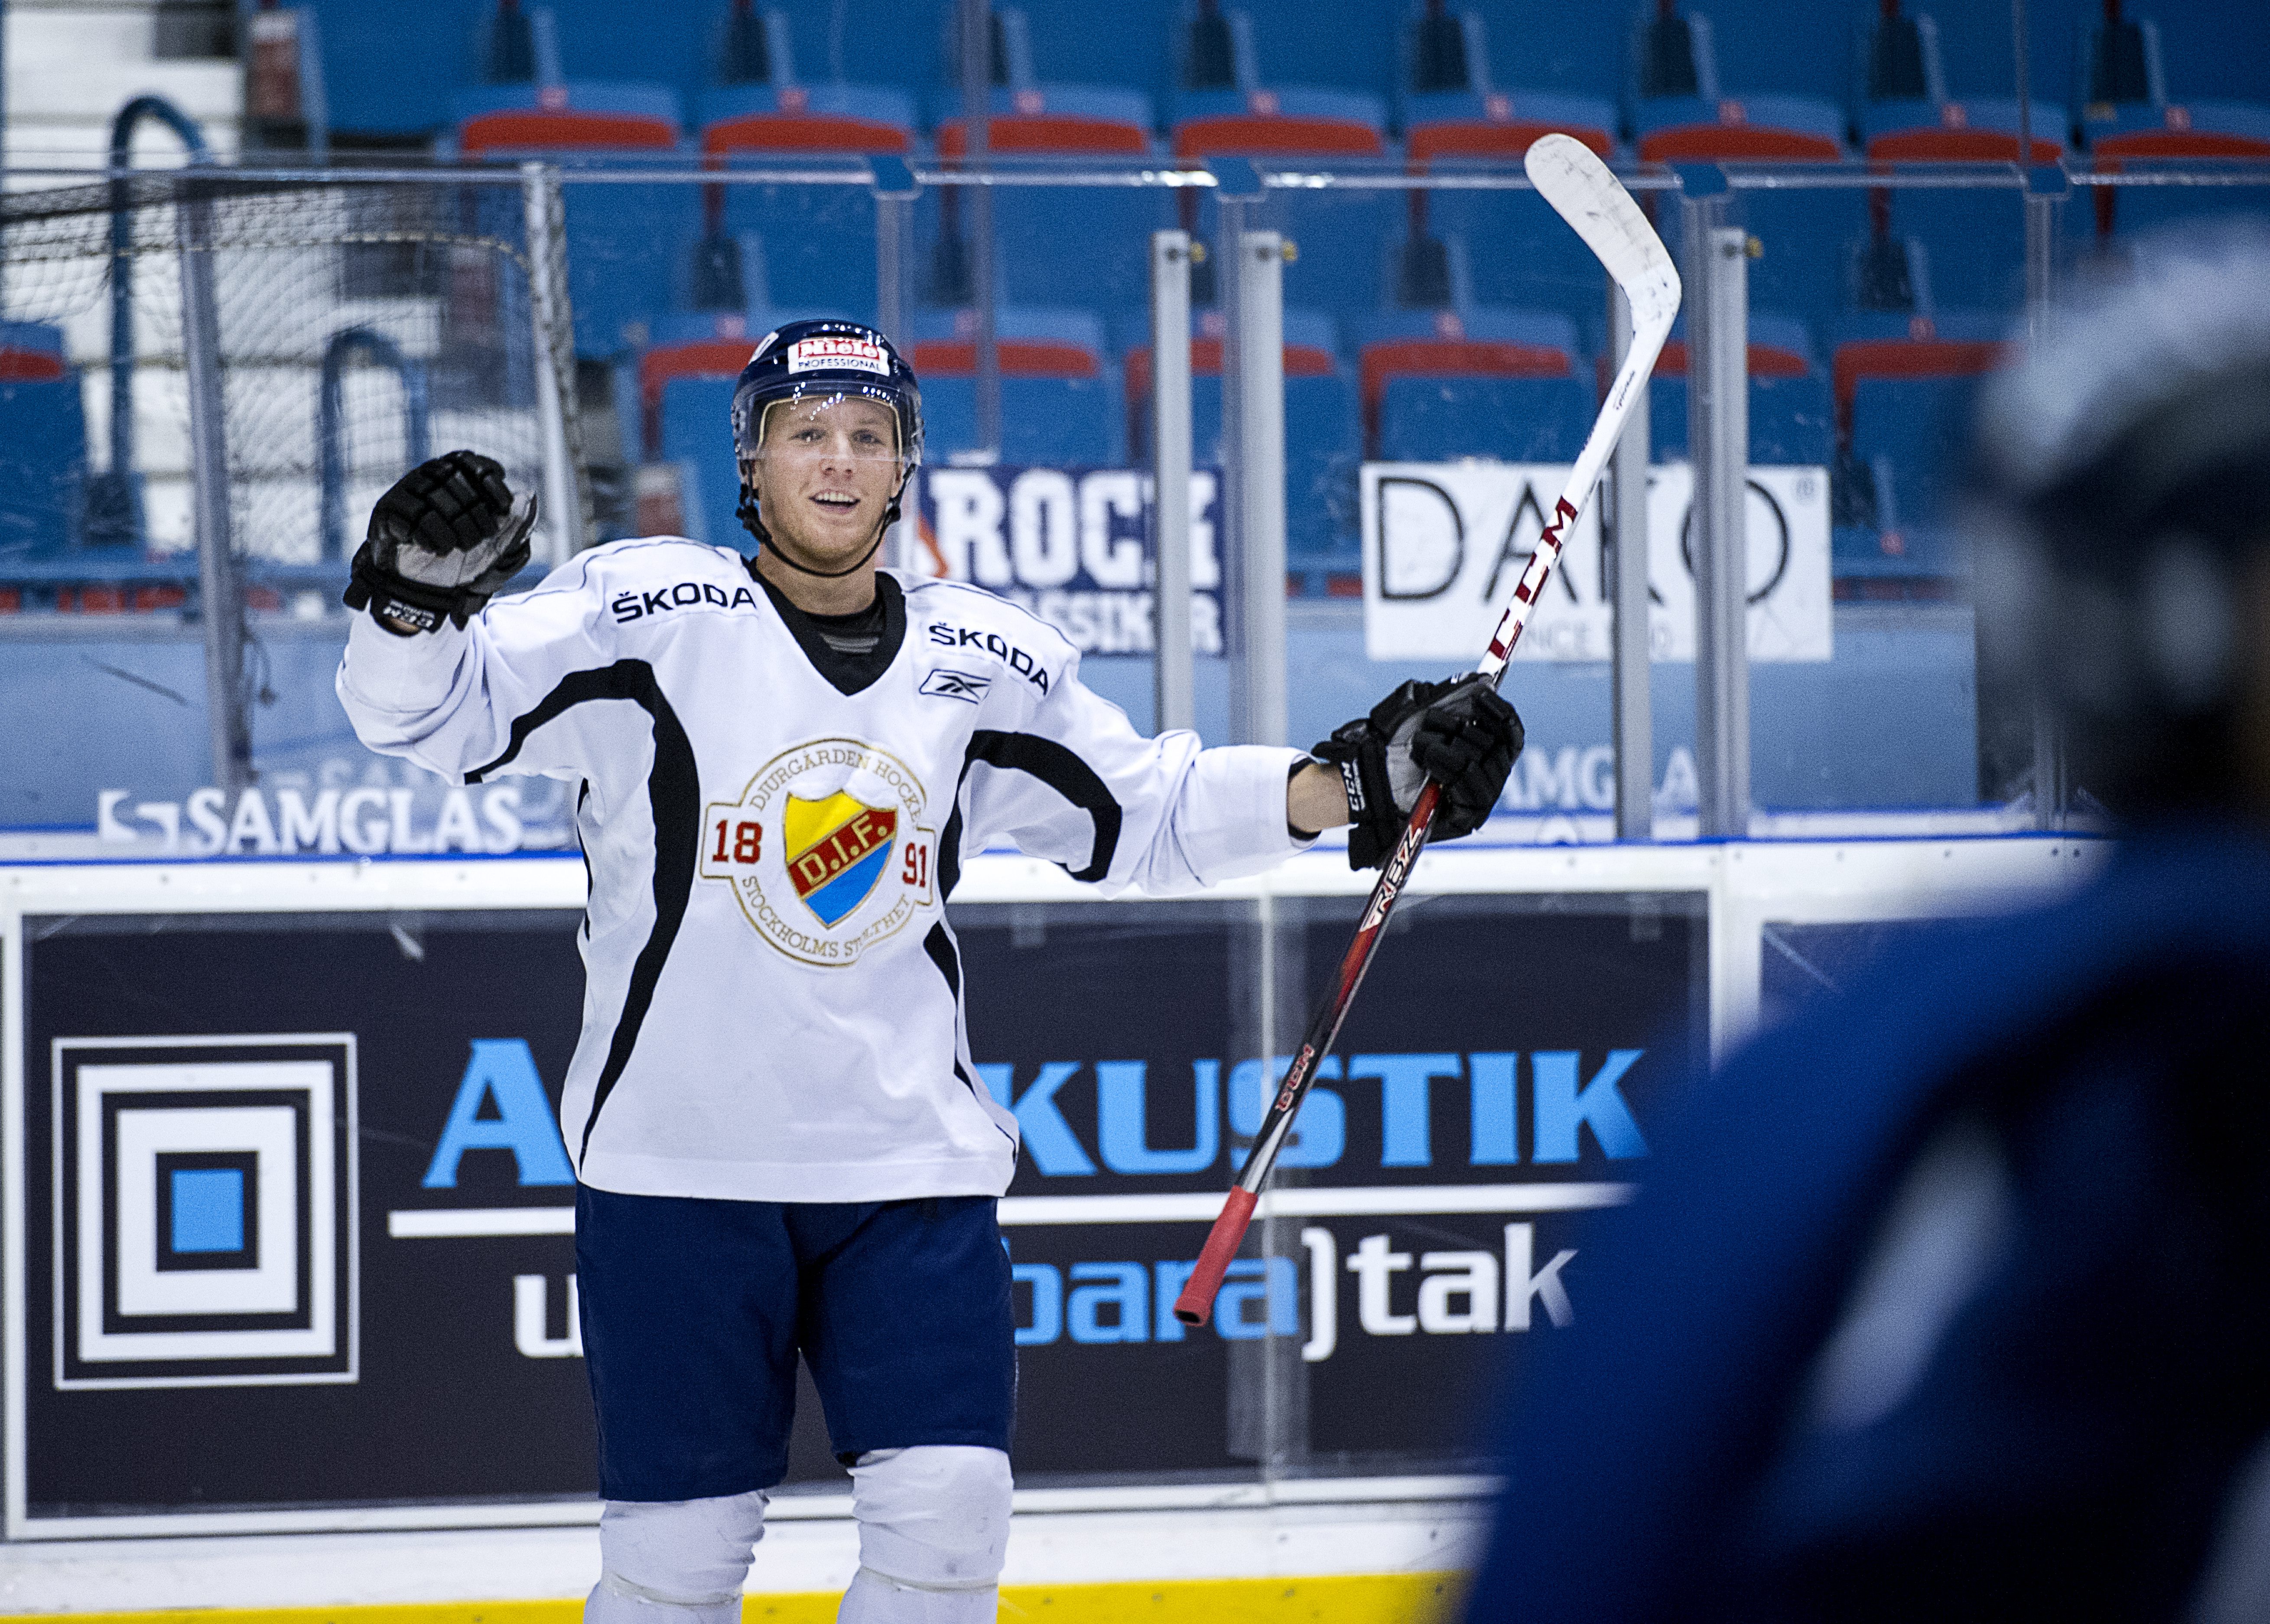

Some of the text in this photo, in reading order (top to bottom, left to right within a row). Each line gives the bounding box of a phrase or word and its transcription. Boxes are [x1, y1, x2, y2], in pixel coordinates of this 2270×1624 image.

[798, 358, 881, 371] PROFESSIONAL
[800, 339, 878, 358] Miele
[611, 582, 757, 623] ŠKODA
[929, 621, 1048, 696] ŠKODA
[749, 747, 871, 812] DJURGÅRDEN
[186, 785, 523, 855] SAMGLAS
[712, 819, 763, 864] 18
[798, 814, 888, 887] D.I.F.
[902, 842, 927, 888] 91
[742, 875, 839, 958] STOCKHOLMS
